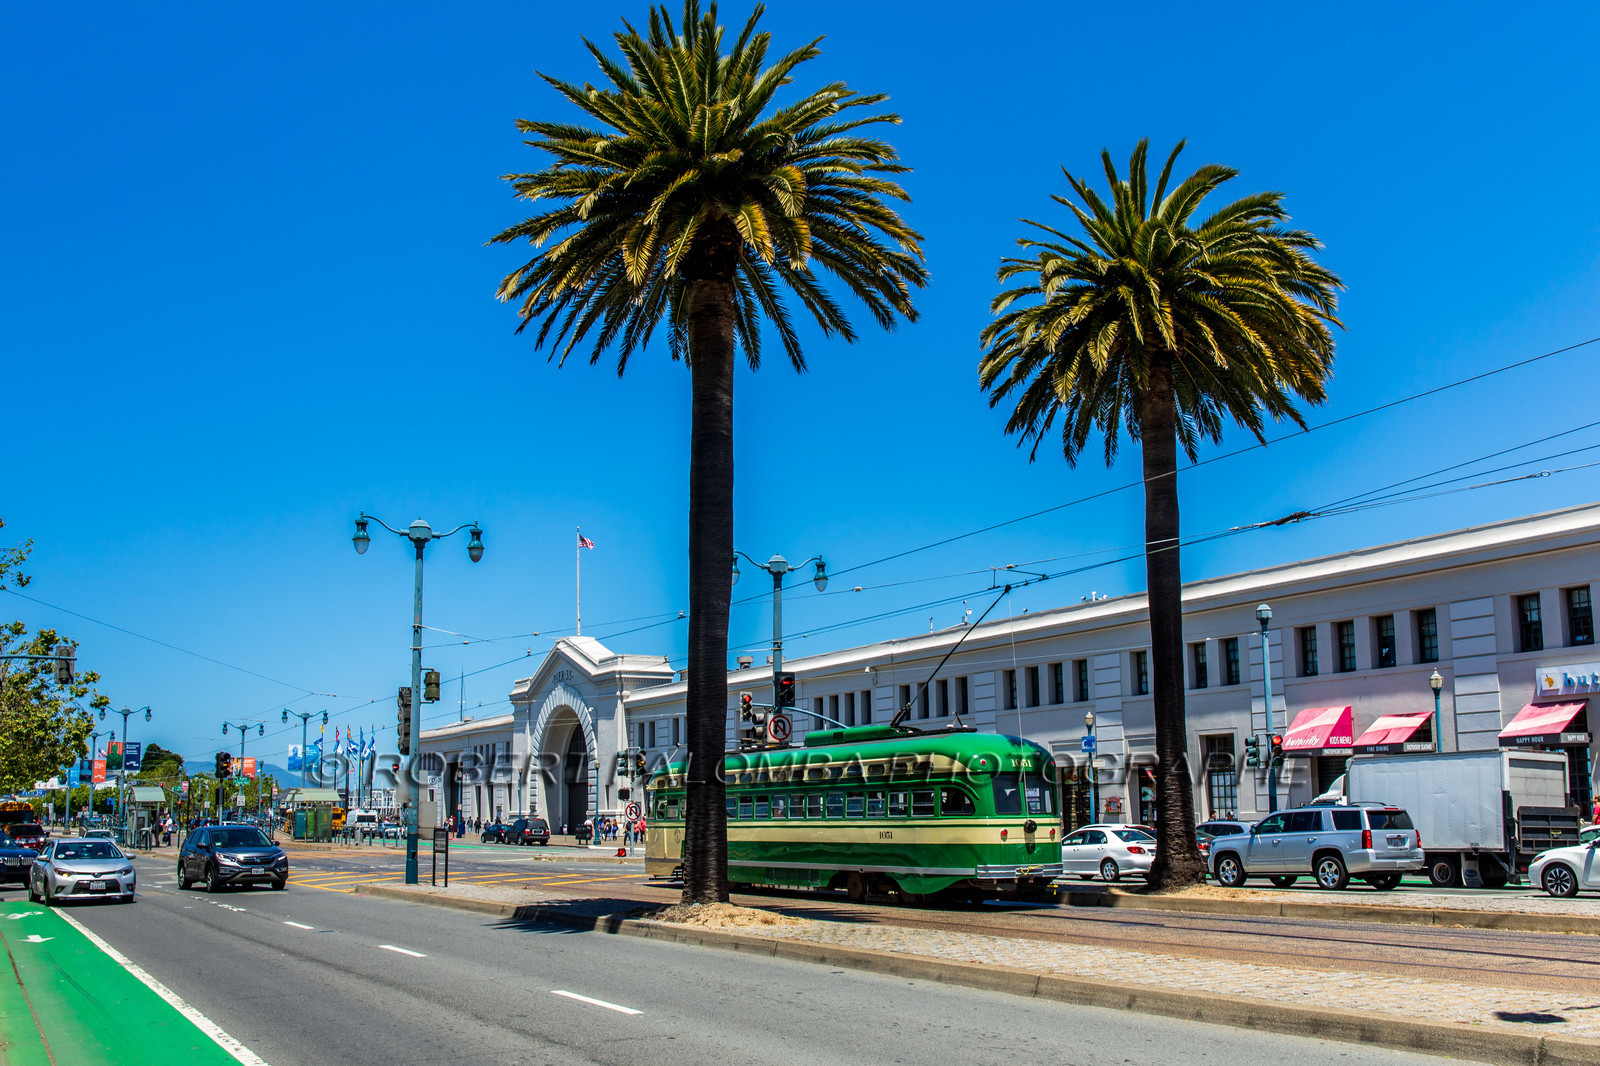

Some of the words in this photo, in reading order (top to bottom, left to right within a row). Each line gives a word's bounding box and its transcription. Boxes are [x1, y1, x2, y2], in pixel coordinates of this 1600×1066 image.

[1329, 736, 1340, 745] KIDS
[1340, 736, 1352, 745] MENU
[1010, 759, 1033, 768] 1051
[879, 831, 893, 840] 1051
